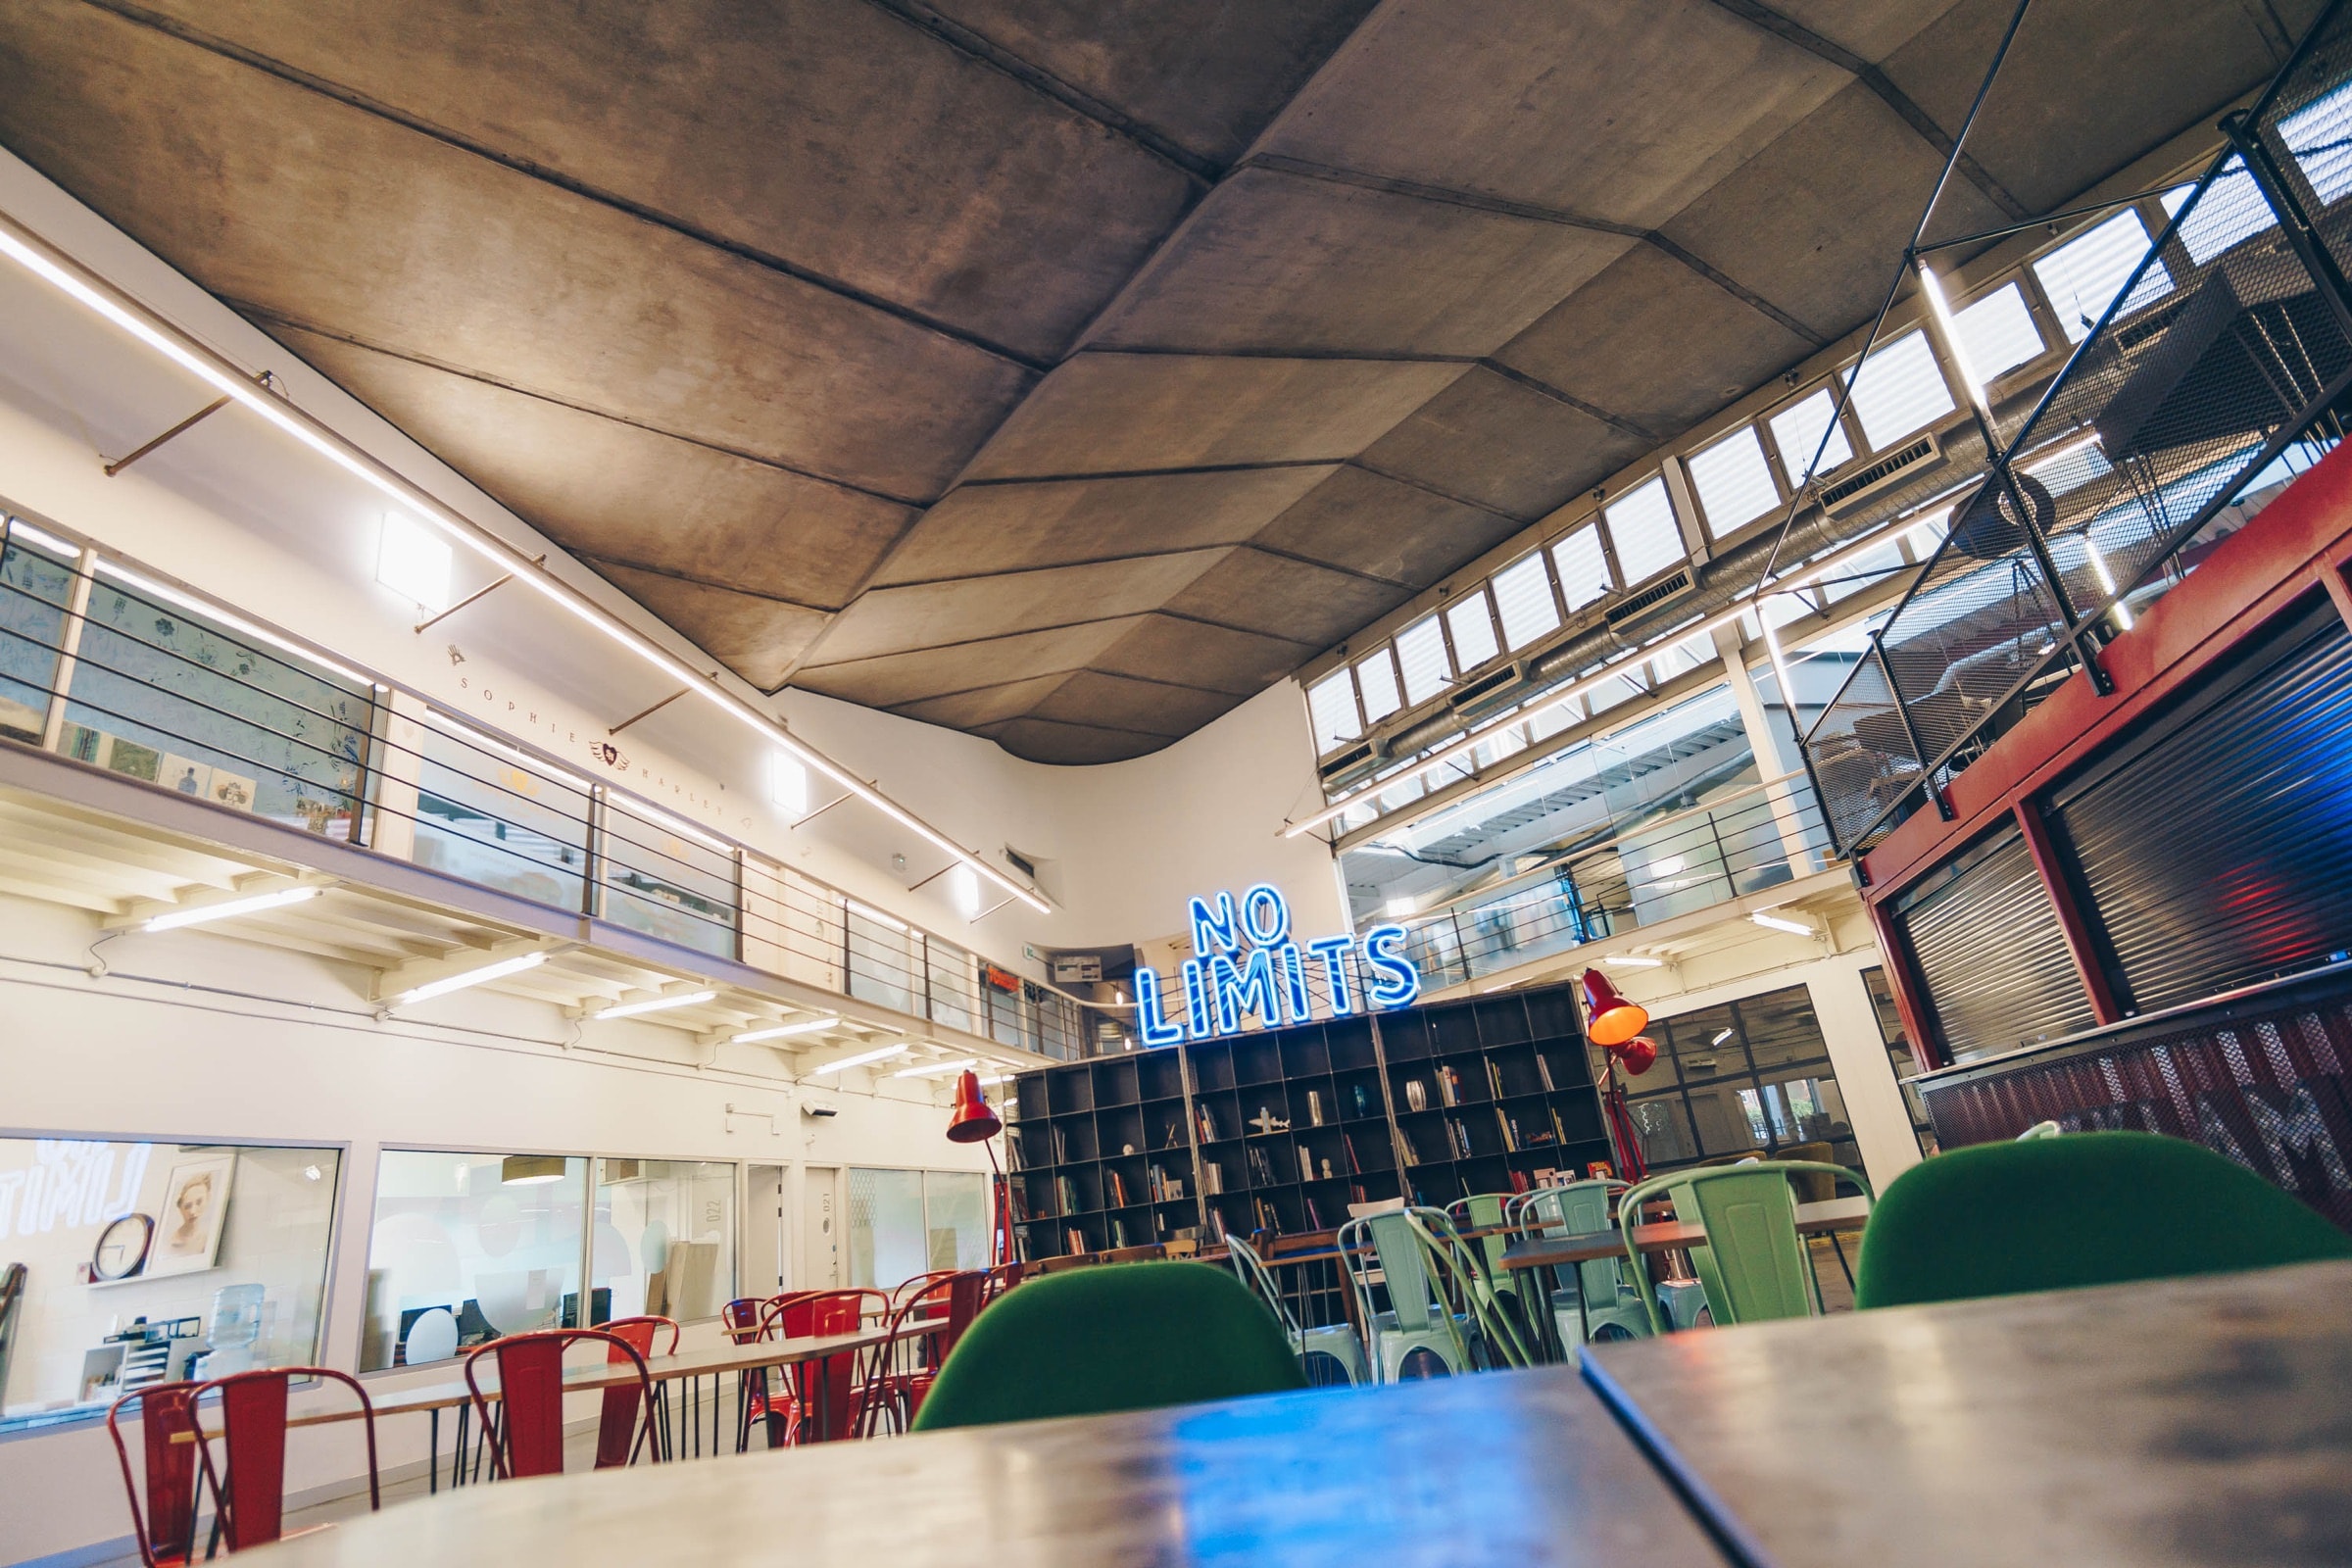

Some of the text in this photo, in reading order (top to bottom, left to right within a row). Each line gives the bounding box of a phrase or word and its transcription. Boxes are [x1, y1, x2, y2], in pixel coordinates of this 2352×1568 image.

[461, 677, 576, 743] SOPHIE
[1188, 882, 1292, 958] NO
[1135, 922, 1419, 1048] LIMITS
